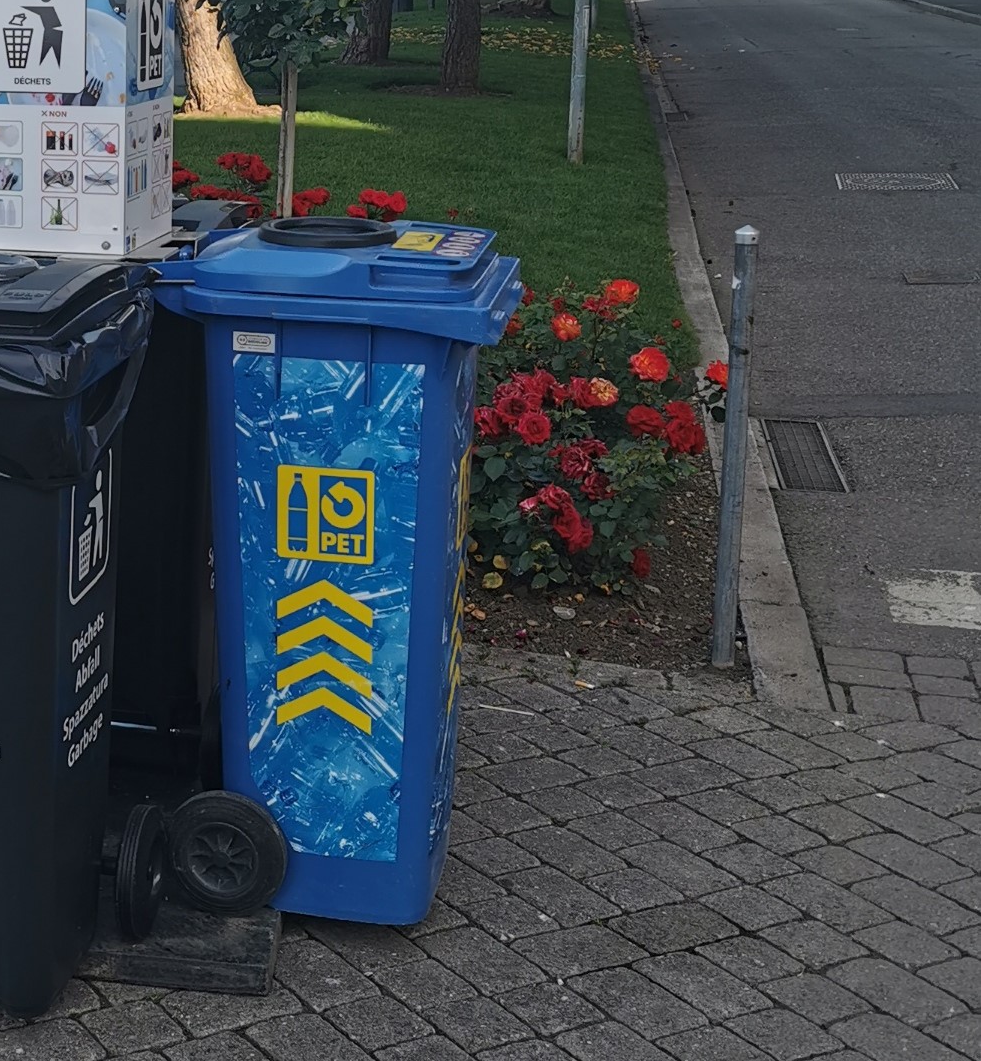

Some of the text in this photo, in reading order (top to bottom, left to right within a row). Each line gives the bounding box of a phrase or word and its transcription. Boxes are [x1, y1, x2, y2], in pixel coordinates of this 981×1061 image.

[14, 76, 51, 86] DÉCHETS
[149, 54, 162, 77] PET
[321, 531, 365, 554] PET
[71, 612, 105, 663] Déchets
[75, 644, 101, 693] Abfall
[62, 672, 109, 742] Spazzatura
[67, 712, 103, 768] Garbage
